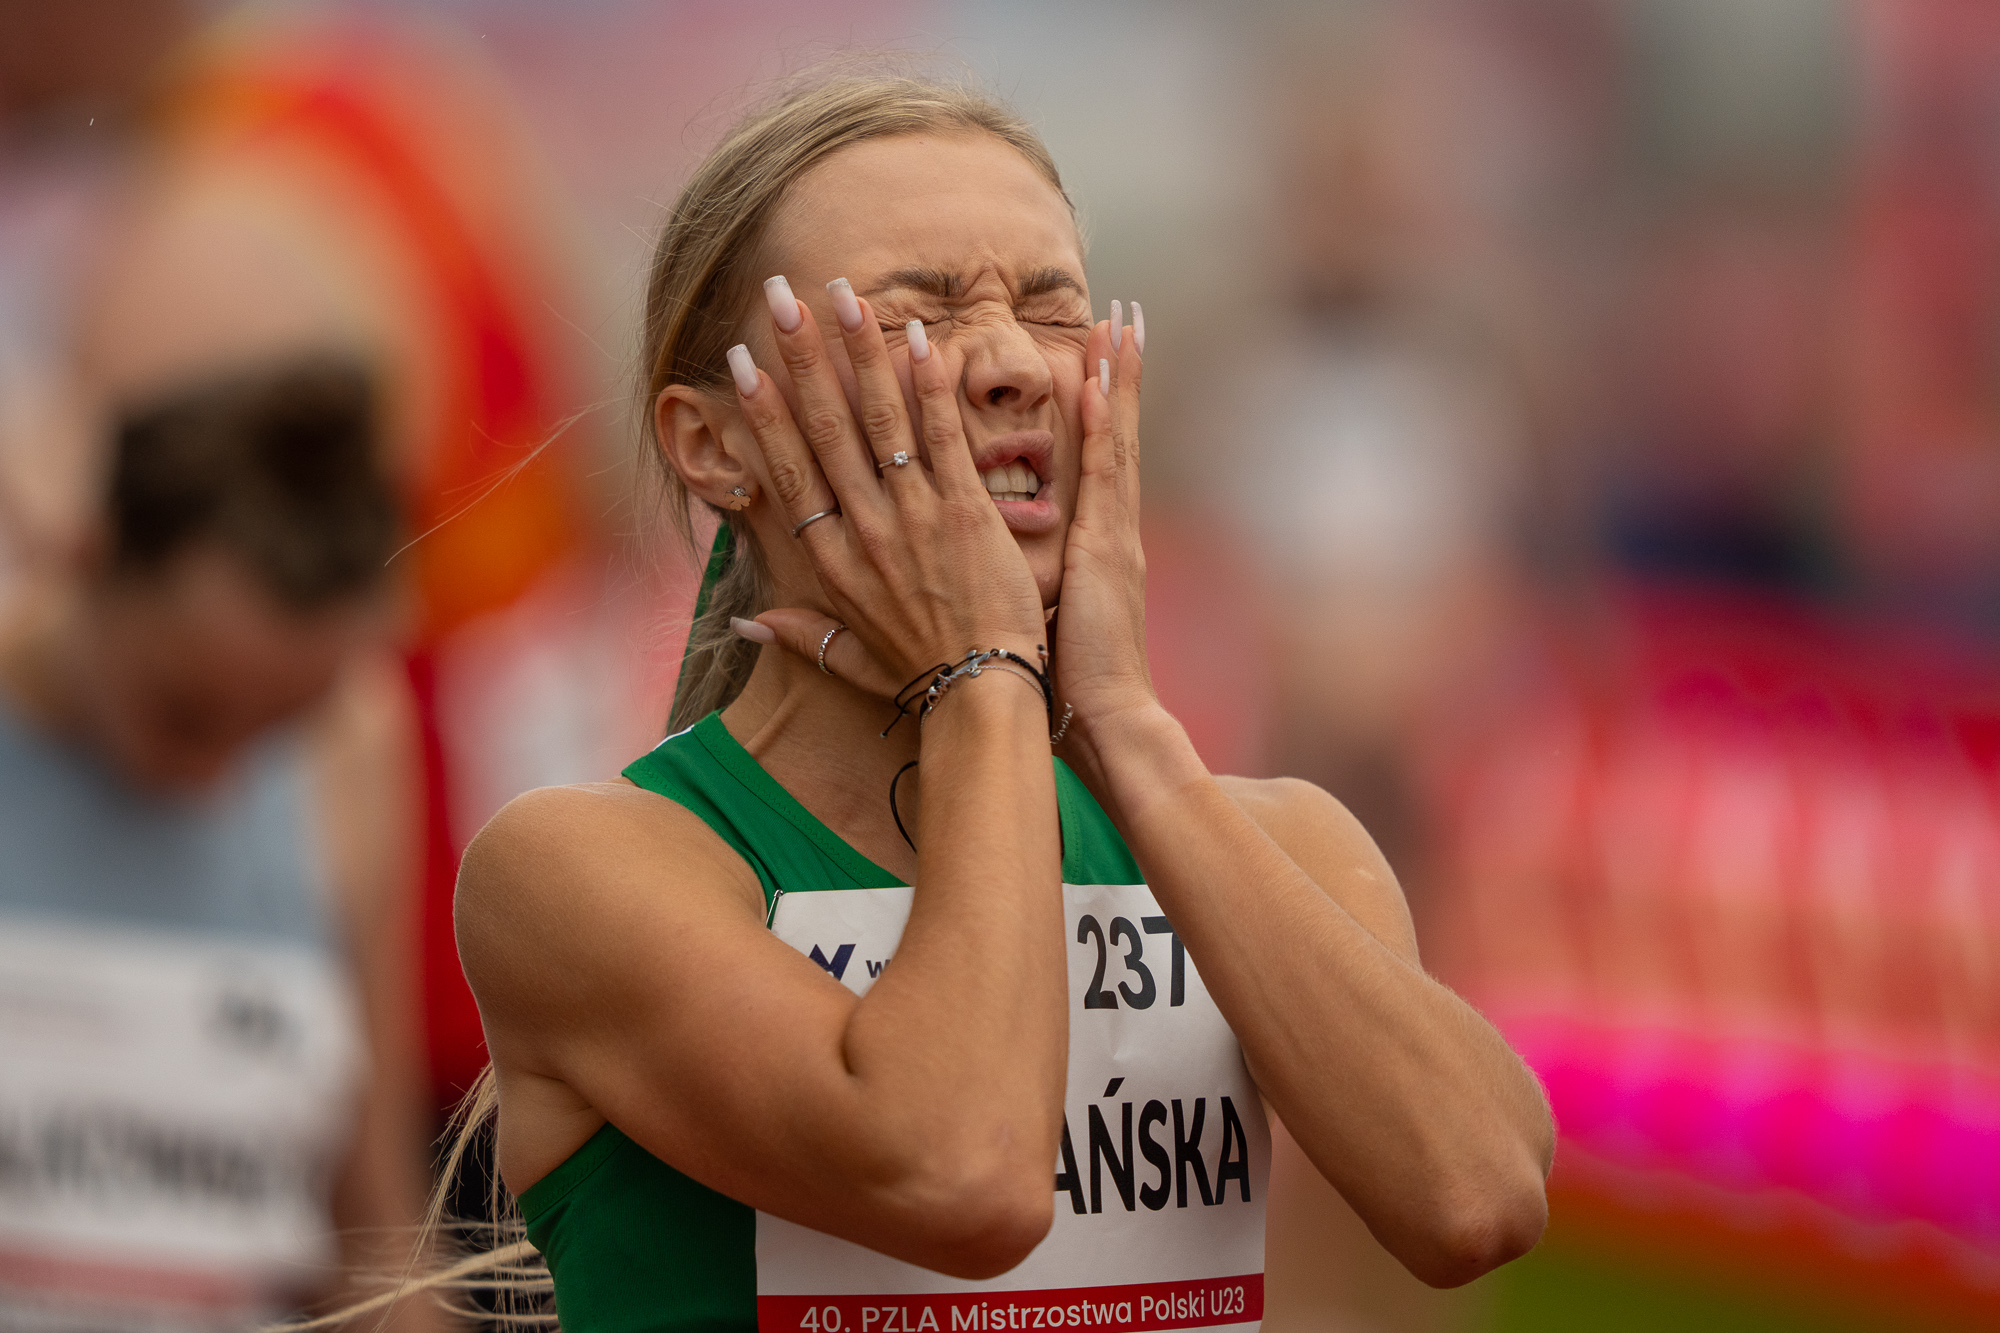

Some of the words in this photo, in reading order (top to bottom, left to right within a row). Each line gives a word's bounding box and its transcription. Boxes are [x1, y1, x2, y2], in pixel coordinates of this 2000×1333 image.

[1077, 914, 1185, 1010] 237
[800, 1306, 850, 1333] 40.
[862, 1306, 940, 1333] PZLA
[951, 1300, 1132, 1332] Mistrzostwa
[1140, 1289, 1205, 1322] Polski
[1210, 1286, 1245, 1316] U23
